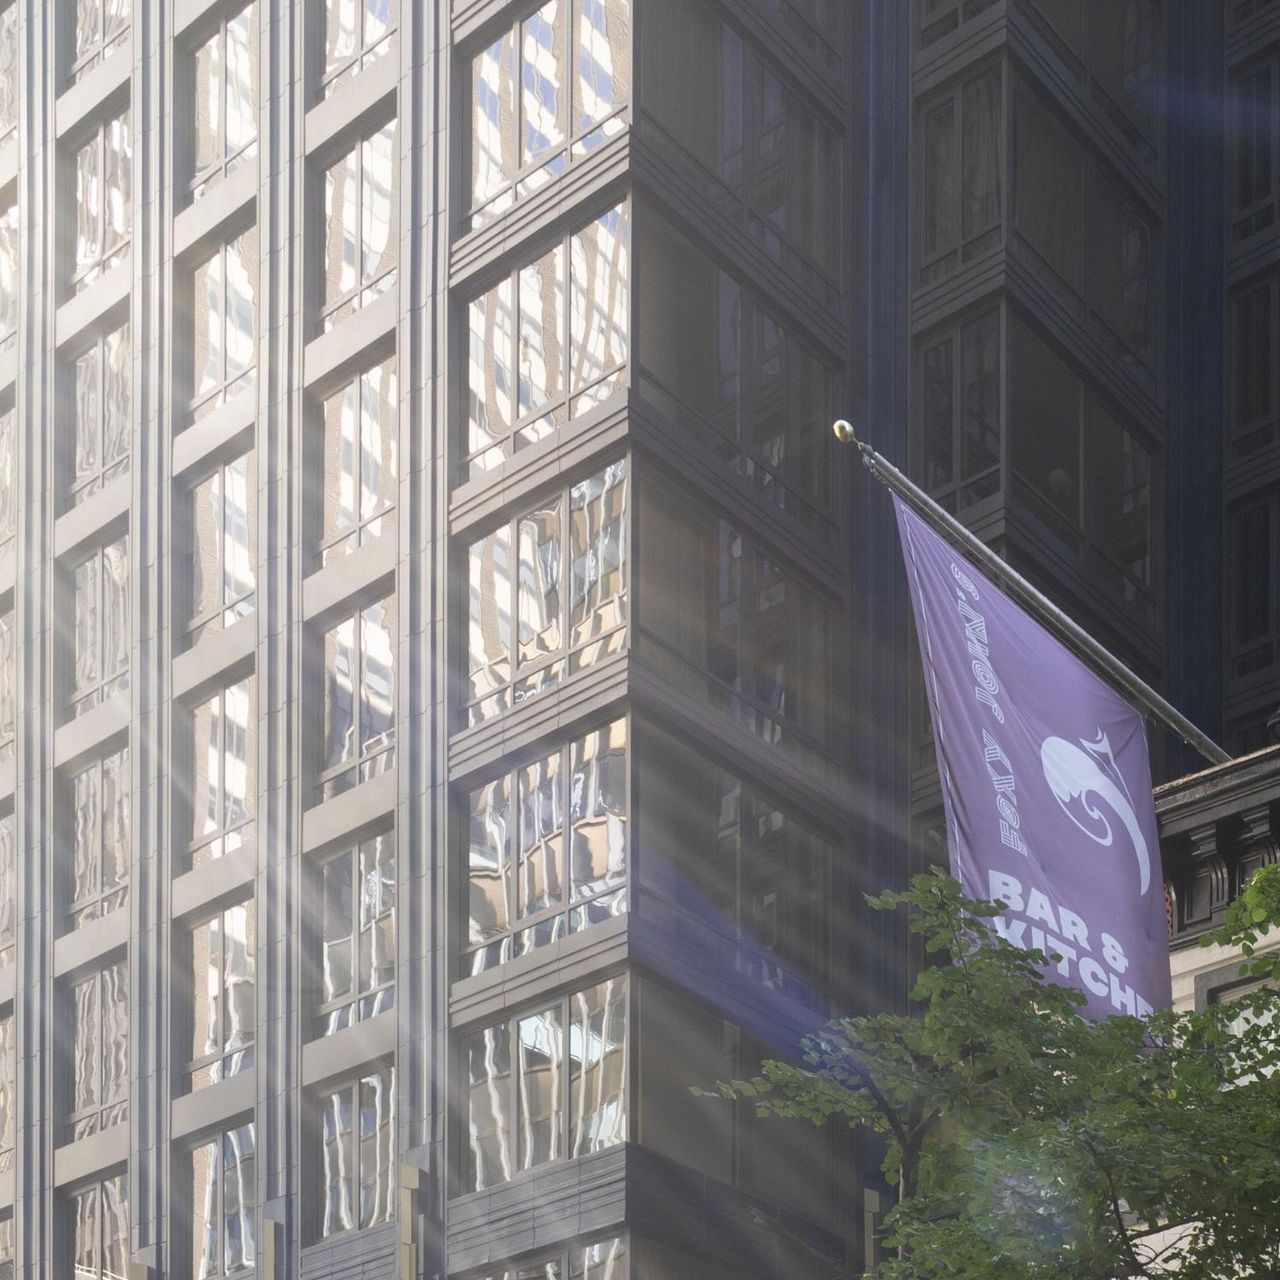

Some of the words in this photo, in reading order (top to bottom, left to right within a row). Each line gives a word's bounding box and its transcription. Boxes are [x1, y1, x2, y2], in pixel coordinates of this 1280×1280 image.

[950, 563, 1005, 724] JOHN'S
[982, 728, 1028, 857] FOXY
[988, 869, 1092, 952] BAR
[1101, 932, 1129, 974] &
[993, 916, 1154, 1021] KITCHE
